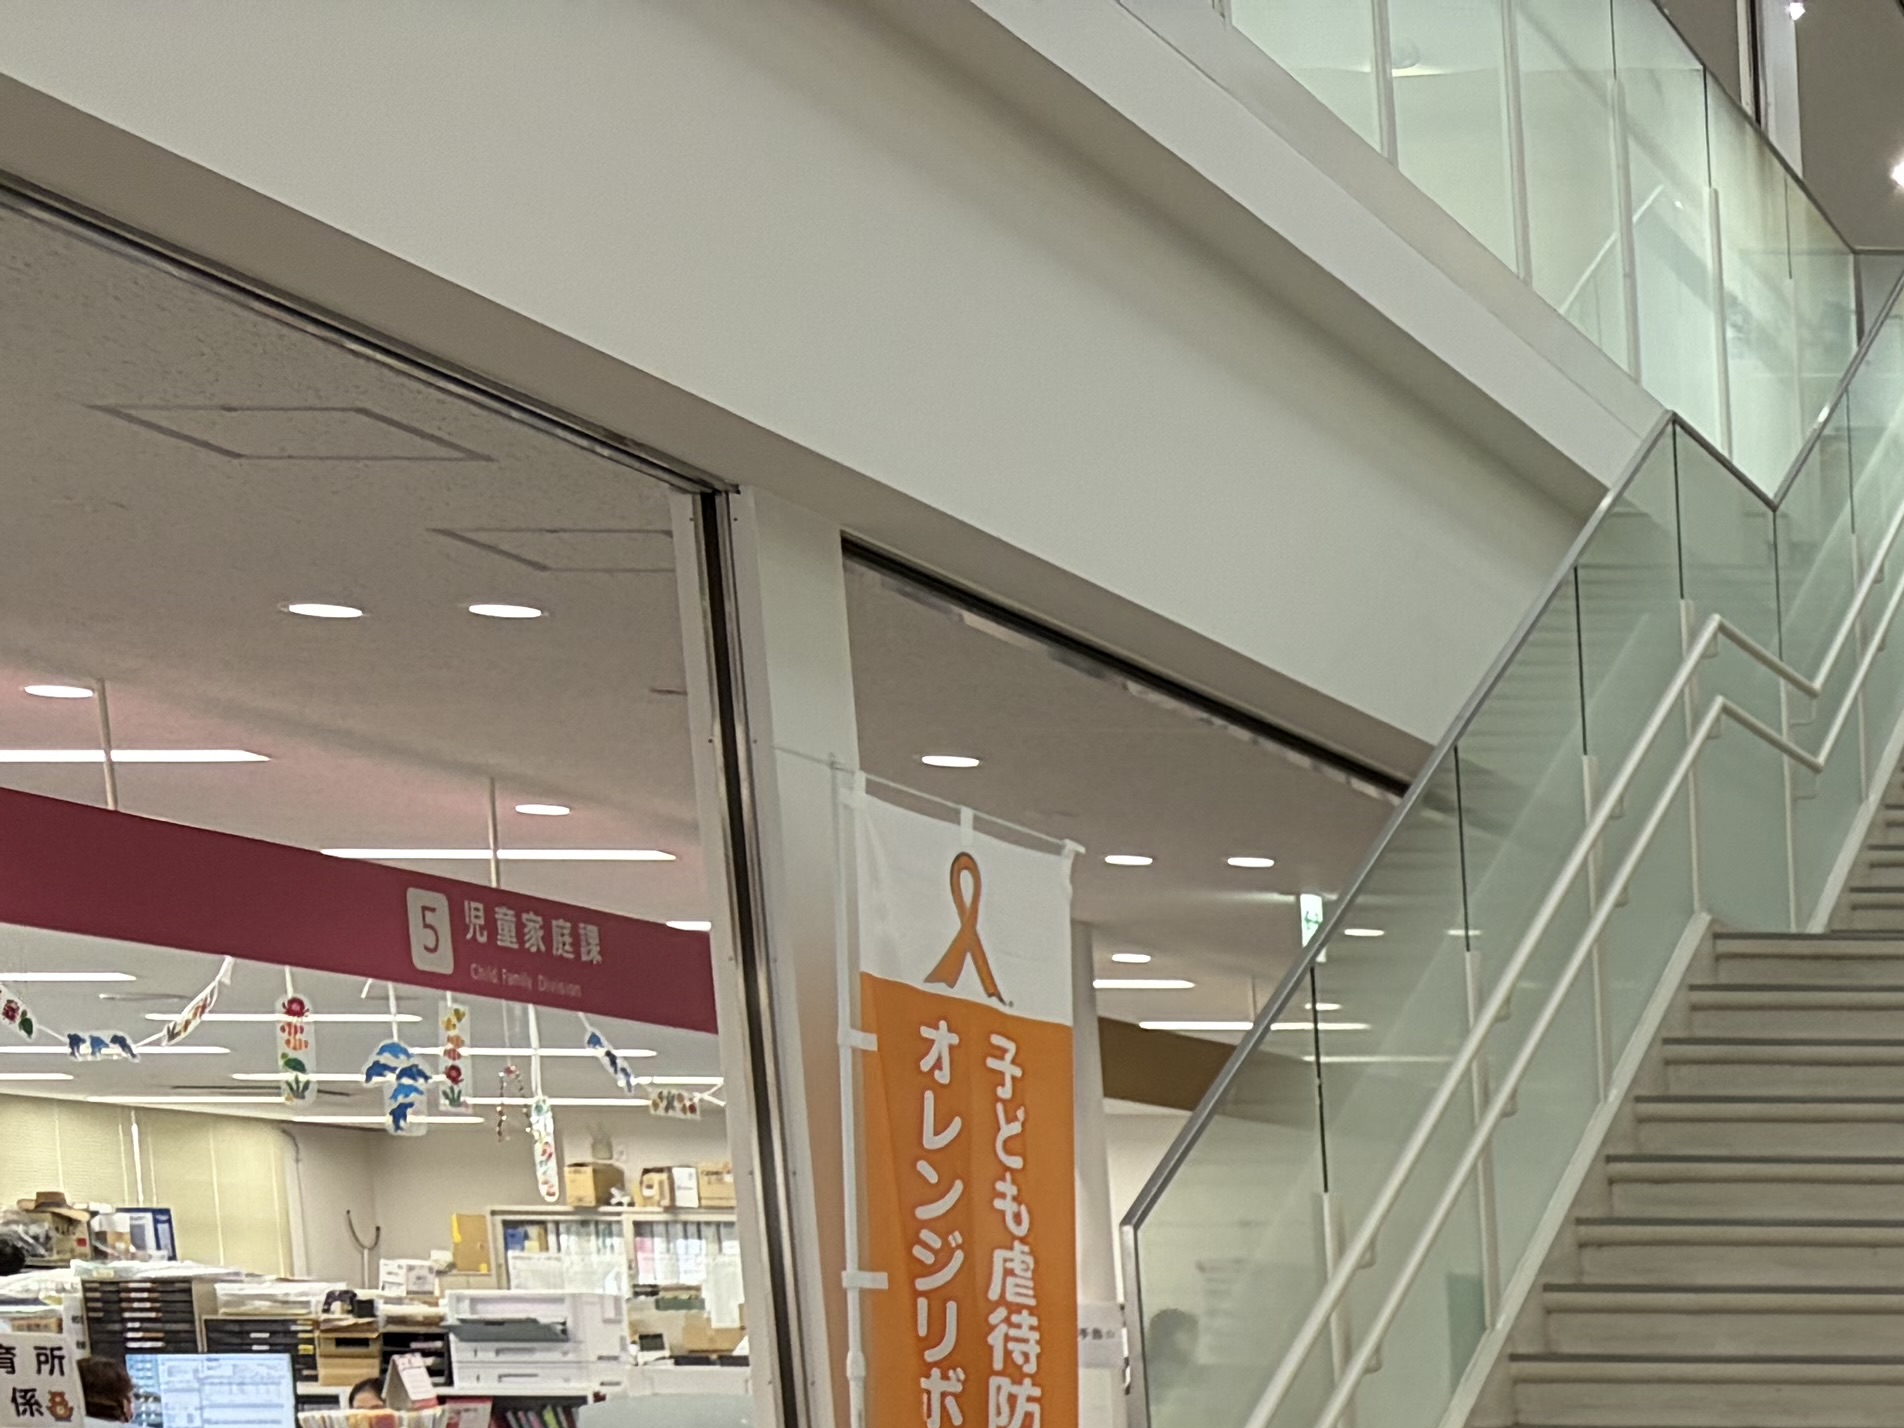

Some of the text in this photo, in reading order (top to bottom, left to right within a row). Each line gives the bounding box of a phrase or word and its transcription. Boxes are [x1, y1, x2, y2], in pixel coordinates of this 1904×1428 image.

[420, 899, 603, 965] 5 児童家庭課
[470, 962, 498, 984] Child
[537, 974, 582, 998] Division
[11, 1386, 44, 1418] 係
